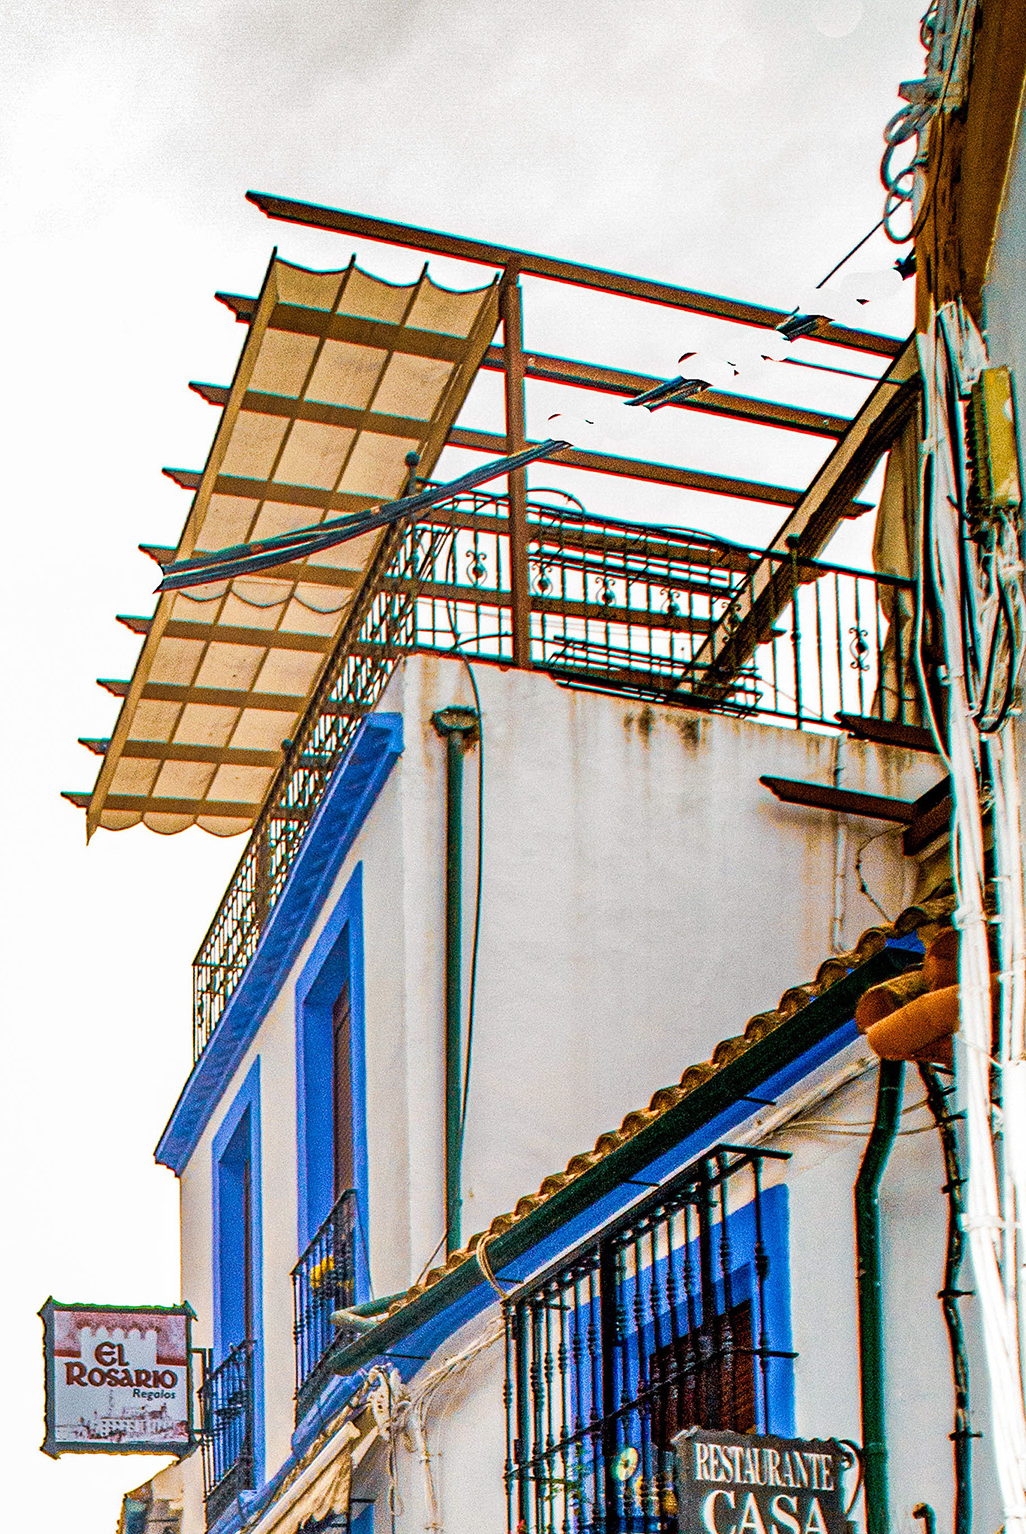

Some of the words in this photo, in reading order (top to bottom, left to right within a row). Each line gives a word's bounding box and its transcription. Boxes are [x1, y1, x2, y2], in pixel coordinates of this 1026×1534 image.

[93, 1341, 129, 1367] EL
[64, 1361, 179, 1389] ROSARIO
[132, 1388, 176, 1402] Regalos
[693, 1442, 835, 1492] RESTAURANTE
